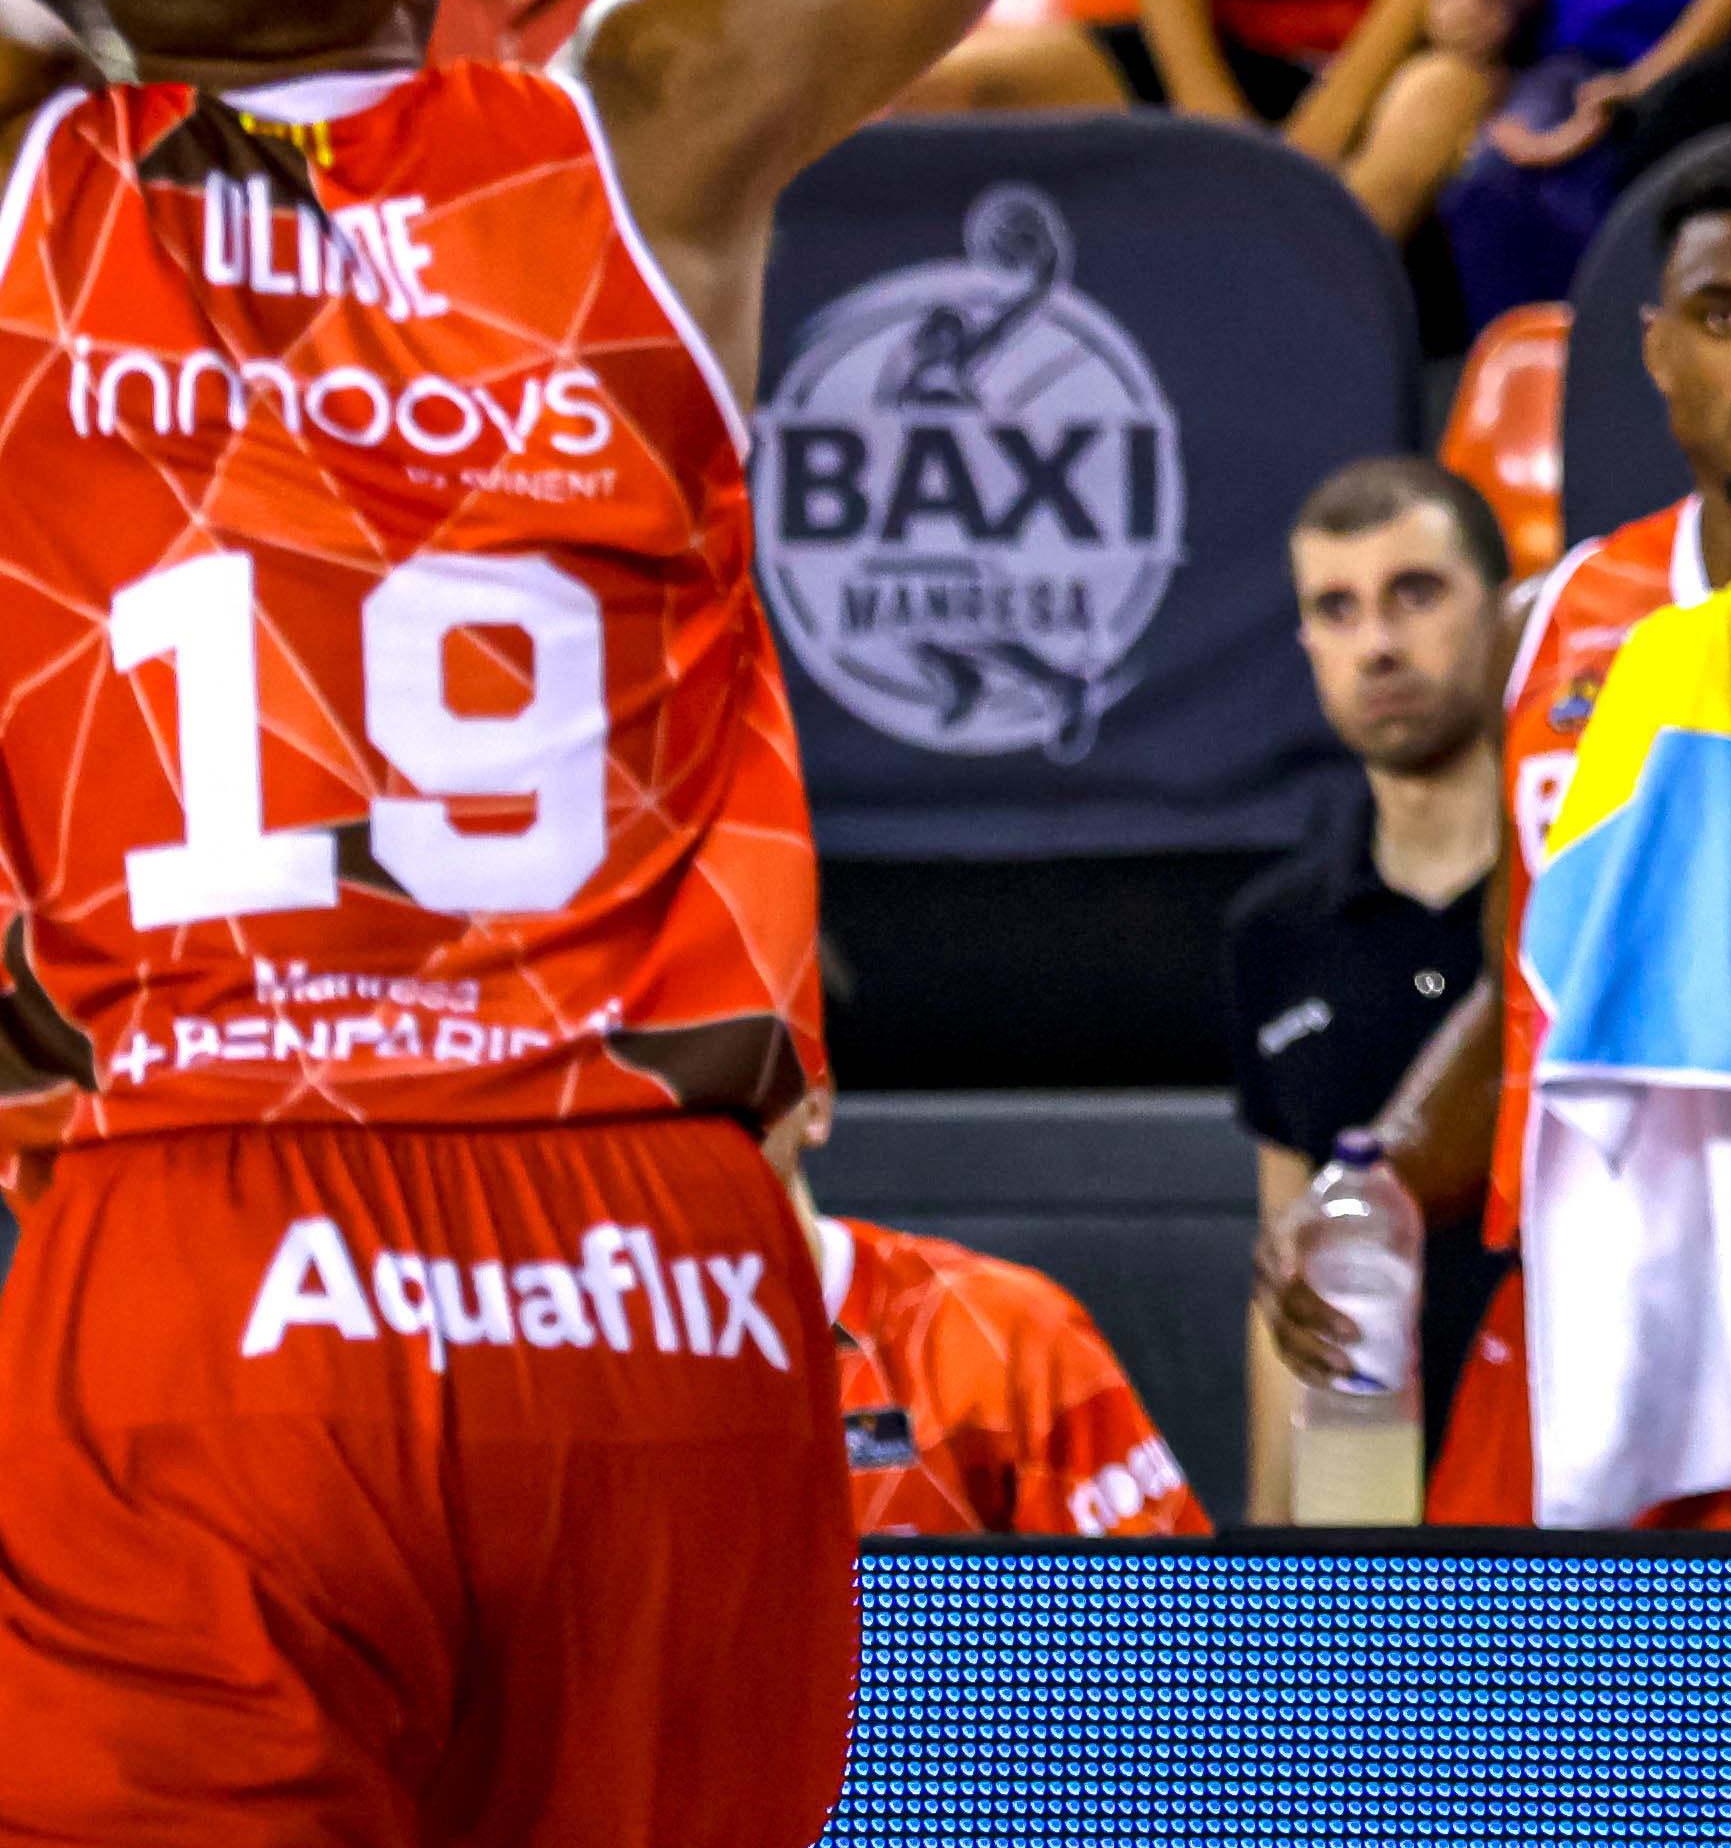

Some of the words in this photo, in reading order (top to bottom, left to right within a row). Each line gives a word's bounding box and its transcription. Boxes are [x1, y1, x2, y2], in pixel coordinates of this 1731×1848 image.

[779, 425, 1159, 542] BAXI
[108, 551, 608, 931] 19
[240, 1215, 790, 1373] Aquaflix
